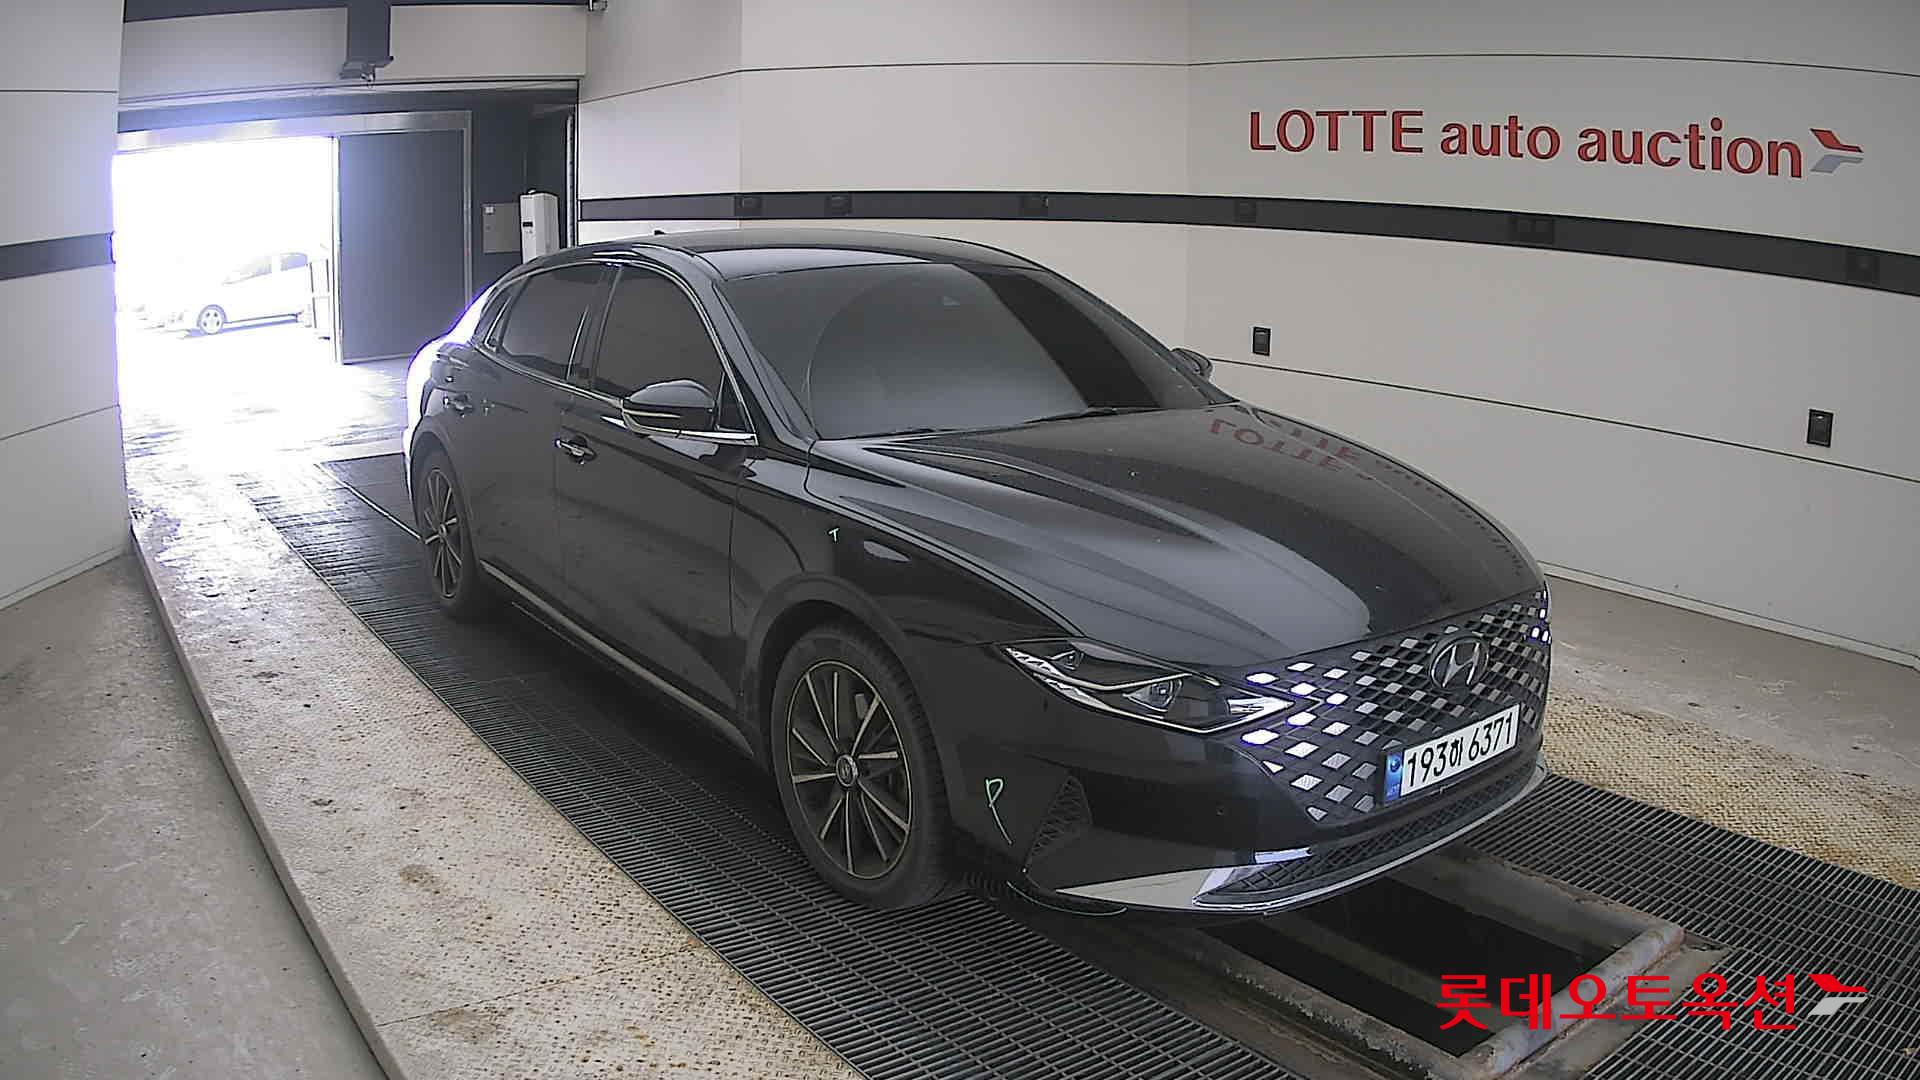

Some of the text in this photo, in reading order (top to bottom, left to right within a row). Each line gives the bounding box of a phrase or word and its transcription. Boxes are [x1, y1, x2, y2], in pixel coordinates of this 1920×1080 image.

[1250, 110, 1802, 178] LOTTE auto auction
[1468, 712, 1513, 762] 6371
